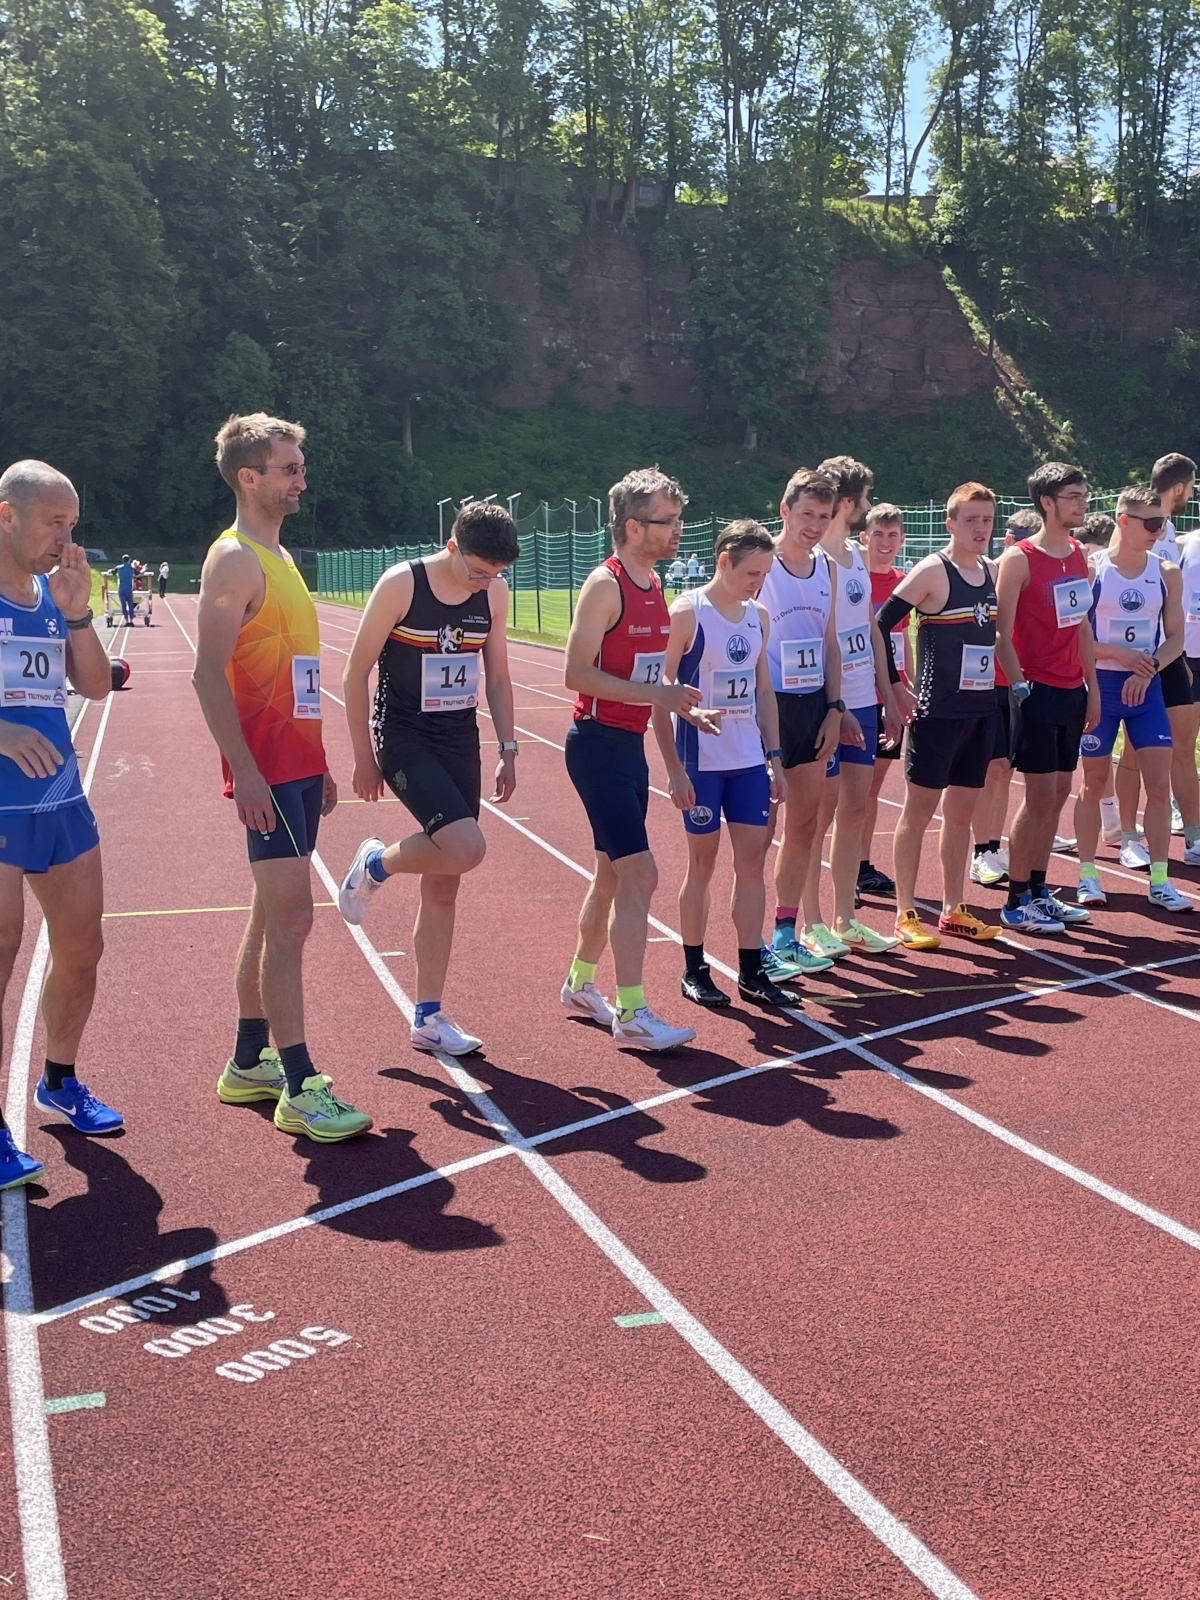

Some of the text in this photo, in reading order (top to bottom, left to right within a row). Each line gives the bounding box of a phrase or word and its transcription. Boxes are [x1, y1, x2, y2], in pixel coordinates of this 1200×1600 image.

[1069, 590, 1078, 608] 8
[772, 615, 780, 623] TJ
[847, 633, 866, 655] 10
[1124, 626, 1136, 643] 6
[19, 650, 50, 680] 20
[797, 648, 817, 669] 11
[980, 655, 989, 673] 9
[440, 664, 467, 689] 14
[643, 662, 661, 685] 13
[727, 677, 748, 699] 12
[945, 922, 978, 937] NITRO
[79, 1287, 201, 1334] 1000
[143, 1303, 275, 1358] 3000
[215, 1325, 352, 1383] 5000
